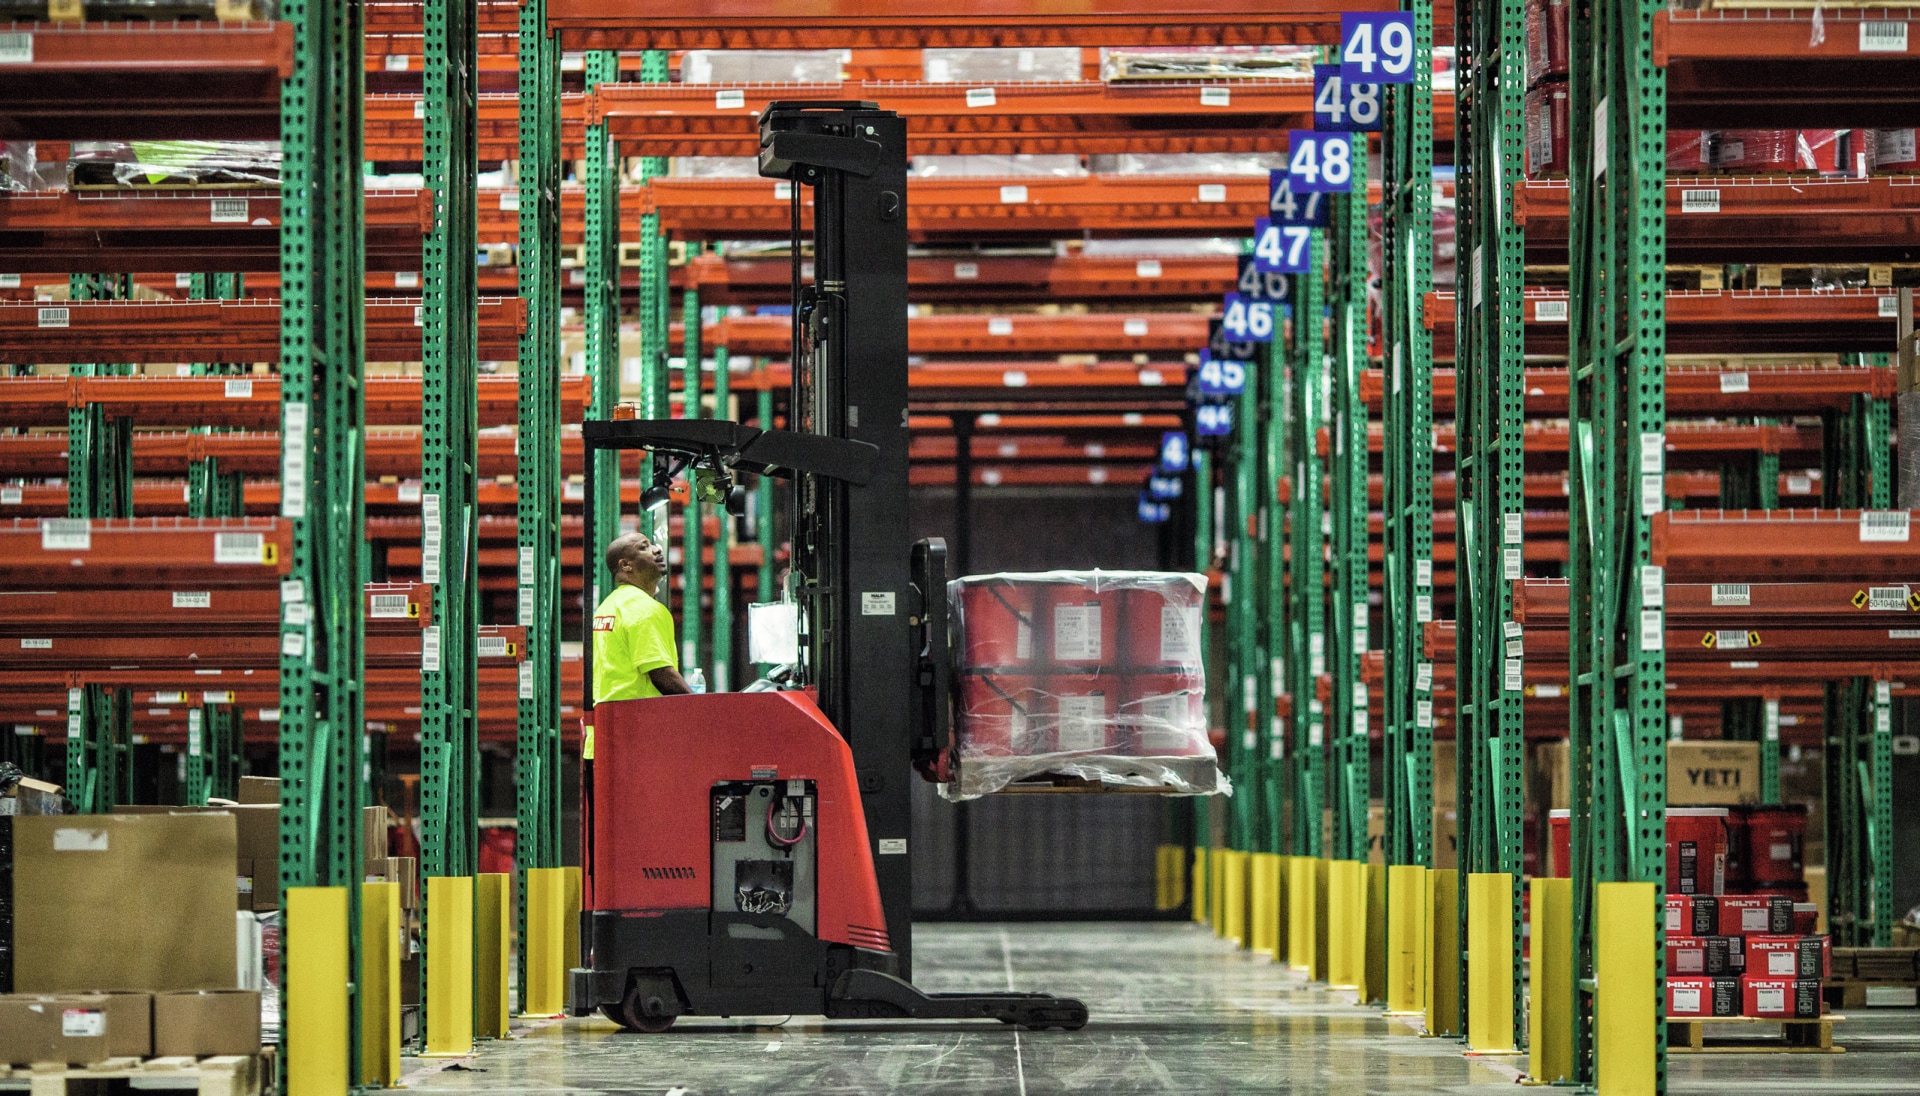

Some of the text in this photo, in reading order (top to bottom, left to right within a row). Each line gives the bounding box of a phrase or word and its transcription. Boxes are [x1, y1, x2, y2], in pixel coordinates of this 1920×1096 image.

[1344, 22, 1413, 74] 49
[1315, 76, 1379, 124] 48
[1290, 138, 1351, 184] 48
[1270, 178, 1321, 220] 47
[1255, 226, 1311, 266] 47
[1238, 262, 1289, 299] 46
[1223, 299, 1273, 337] 46
[1200, 360, 1245, 388] 45
[1869, 599, 1906, 608] 50-10-01-A
[593, 617, 615, 630] ILTI
[1687, 768, 1741, 786] YETI
